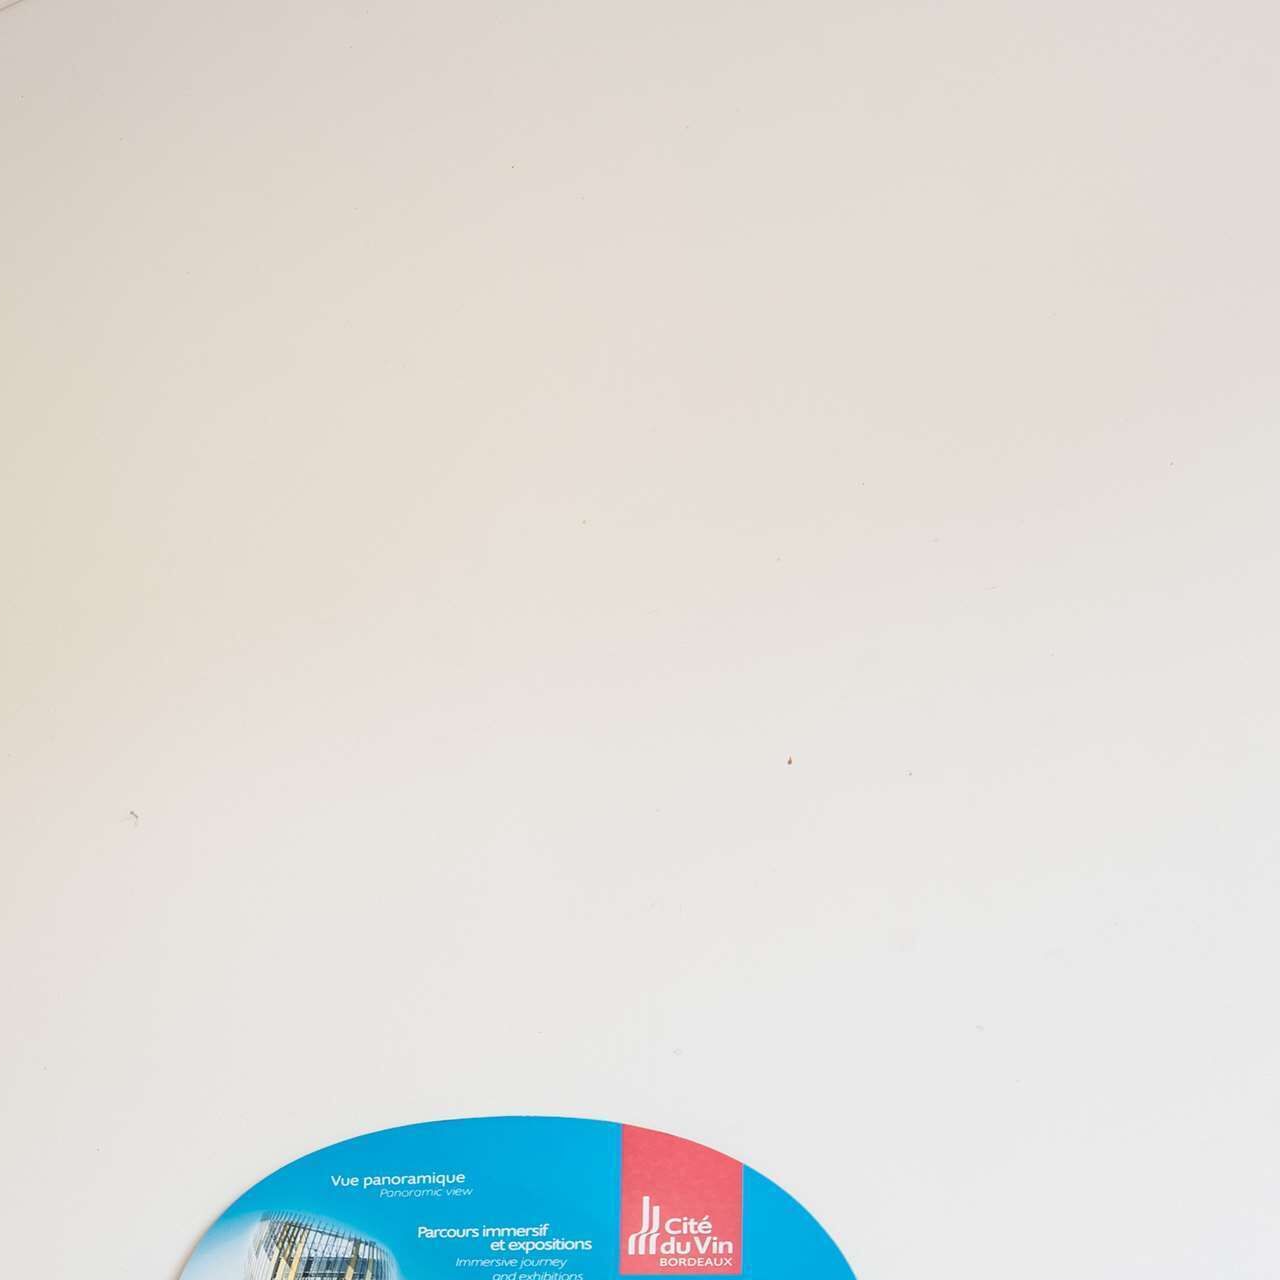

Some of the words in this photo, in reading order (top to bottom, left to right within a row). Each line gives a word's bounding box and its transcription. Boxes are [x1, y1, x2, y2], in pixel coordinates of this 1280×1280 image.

[330, 1175, 359, 1188] Vue
[363, 1171, 466, 1190] panoramique
[379, 1186, 443, 1199] Panoramic
[446, 1186, 473, 1197] view
[417, 1224, 479, 1239] Parcours
[482, 1223, 549, 1239] immersif
[664, 1215, 712, 1236] Cité
[491, 1240, 506, 1251] et
[508, 1238, 592, 1254] expositions
[660, 1236, 693, 1256] du
[694, 1235, 733, 1255] Vin
[456, 1257, 518, 1267] Immersive
[520, 1257, 567, 1270] journey
[659, 1257, 733, 1267] BORDEAUX
